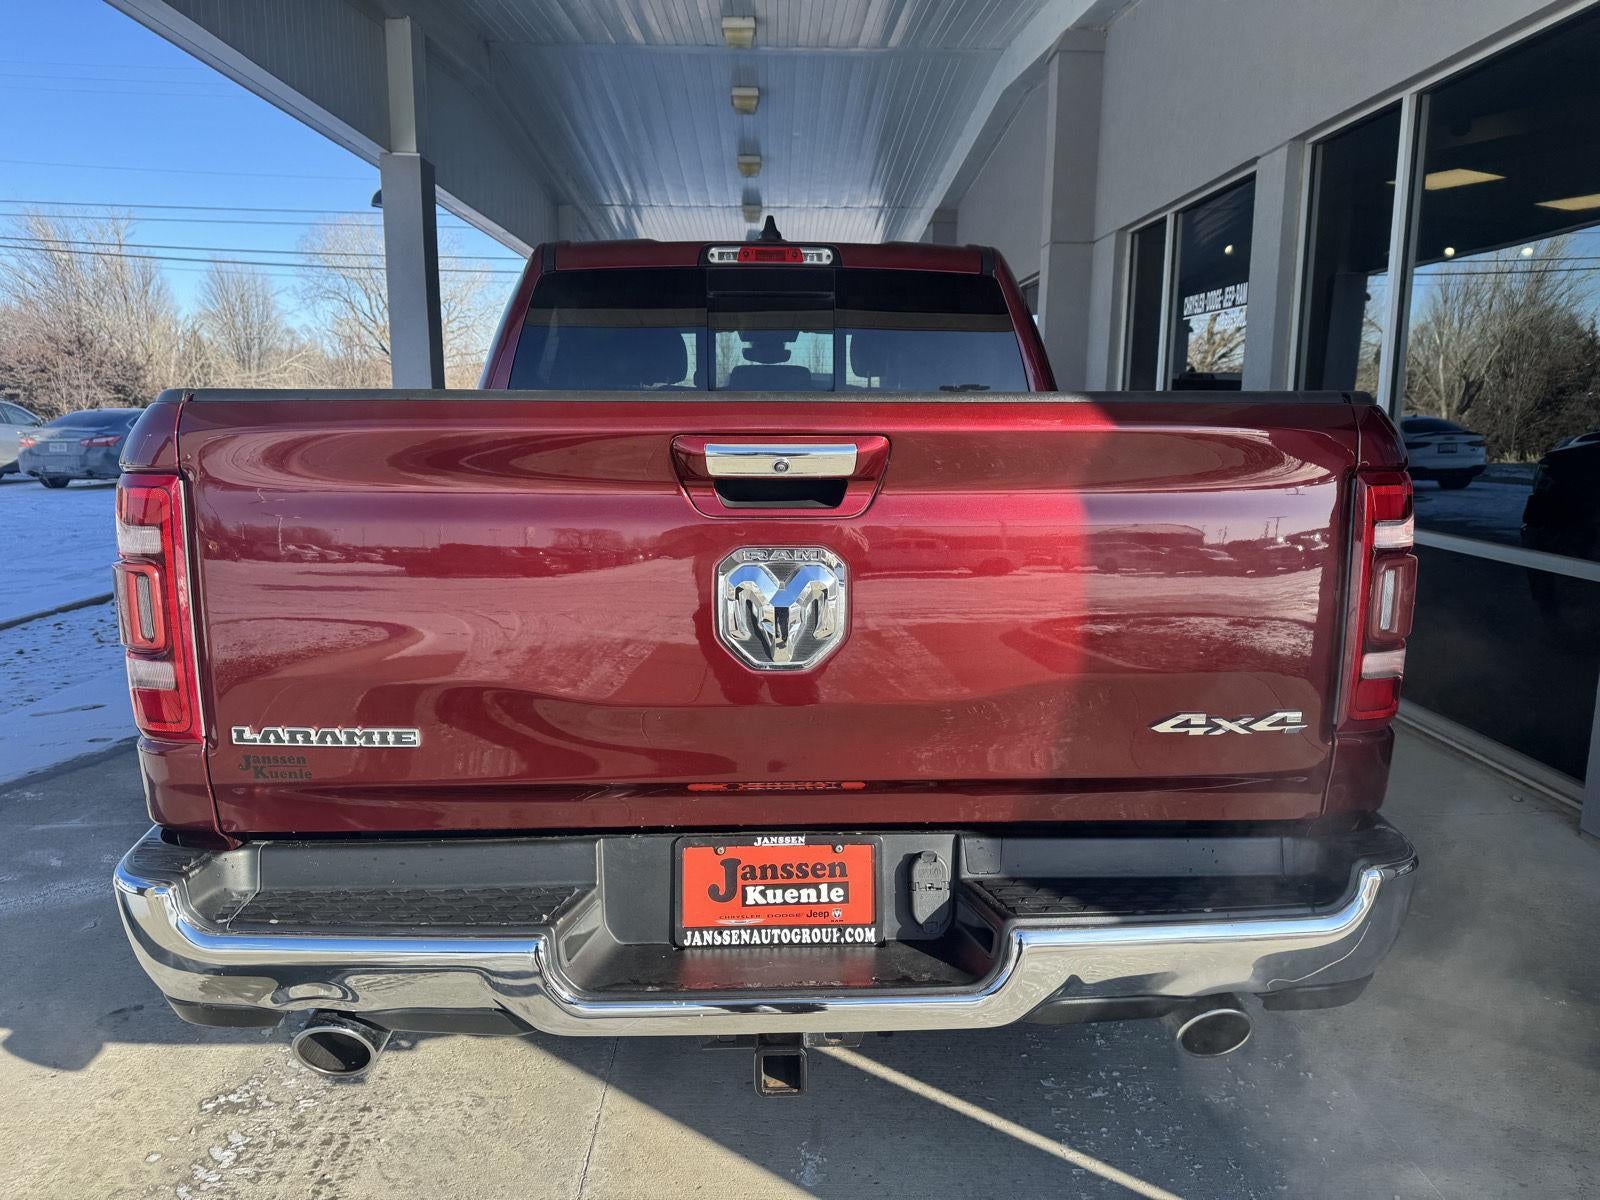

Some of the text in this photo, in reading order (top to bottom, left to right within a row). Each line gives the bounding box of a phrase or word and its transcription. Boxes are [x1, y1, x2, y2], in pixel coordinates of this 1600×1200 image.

[743, 549, 820, 561] RAM
[231, 725, 421, 748] LARAMIE
[239, 754, 307, 771] Janssen
[253, 765, 313, 780] Kuenle
[754, 836, 806, 846] JANSSEN
[708, 858, 848, 903] Janssen
[745, 883, 845, 905] Kuenle
[806, 909, 830, 919] Jeep
[683, 927, 876, 946] JANSSENAUTOGROUP.COM
